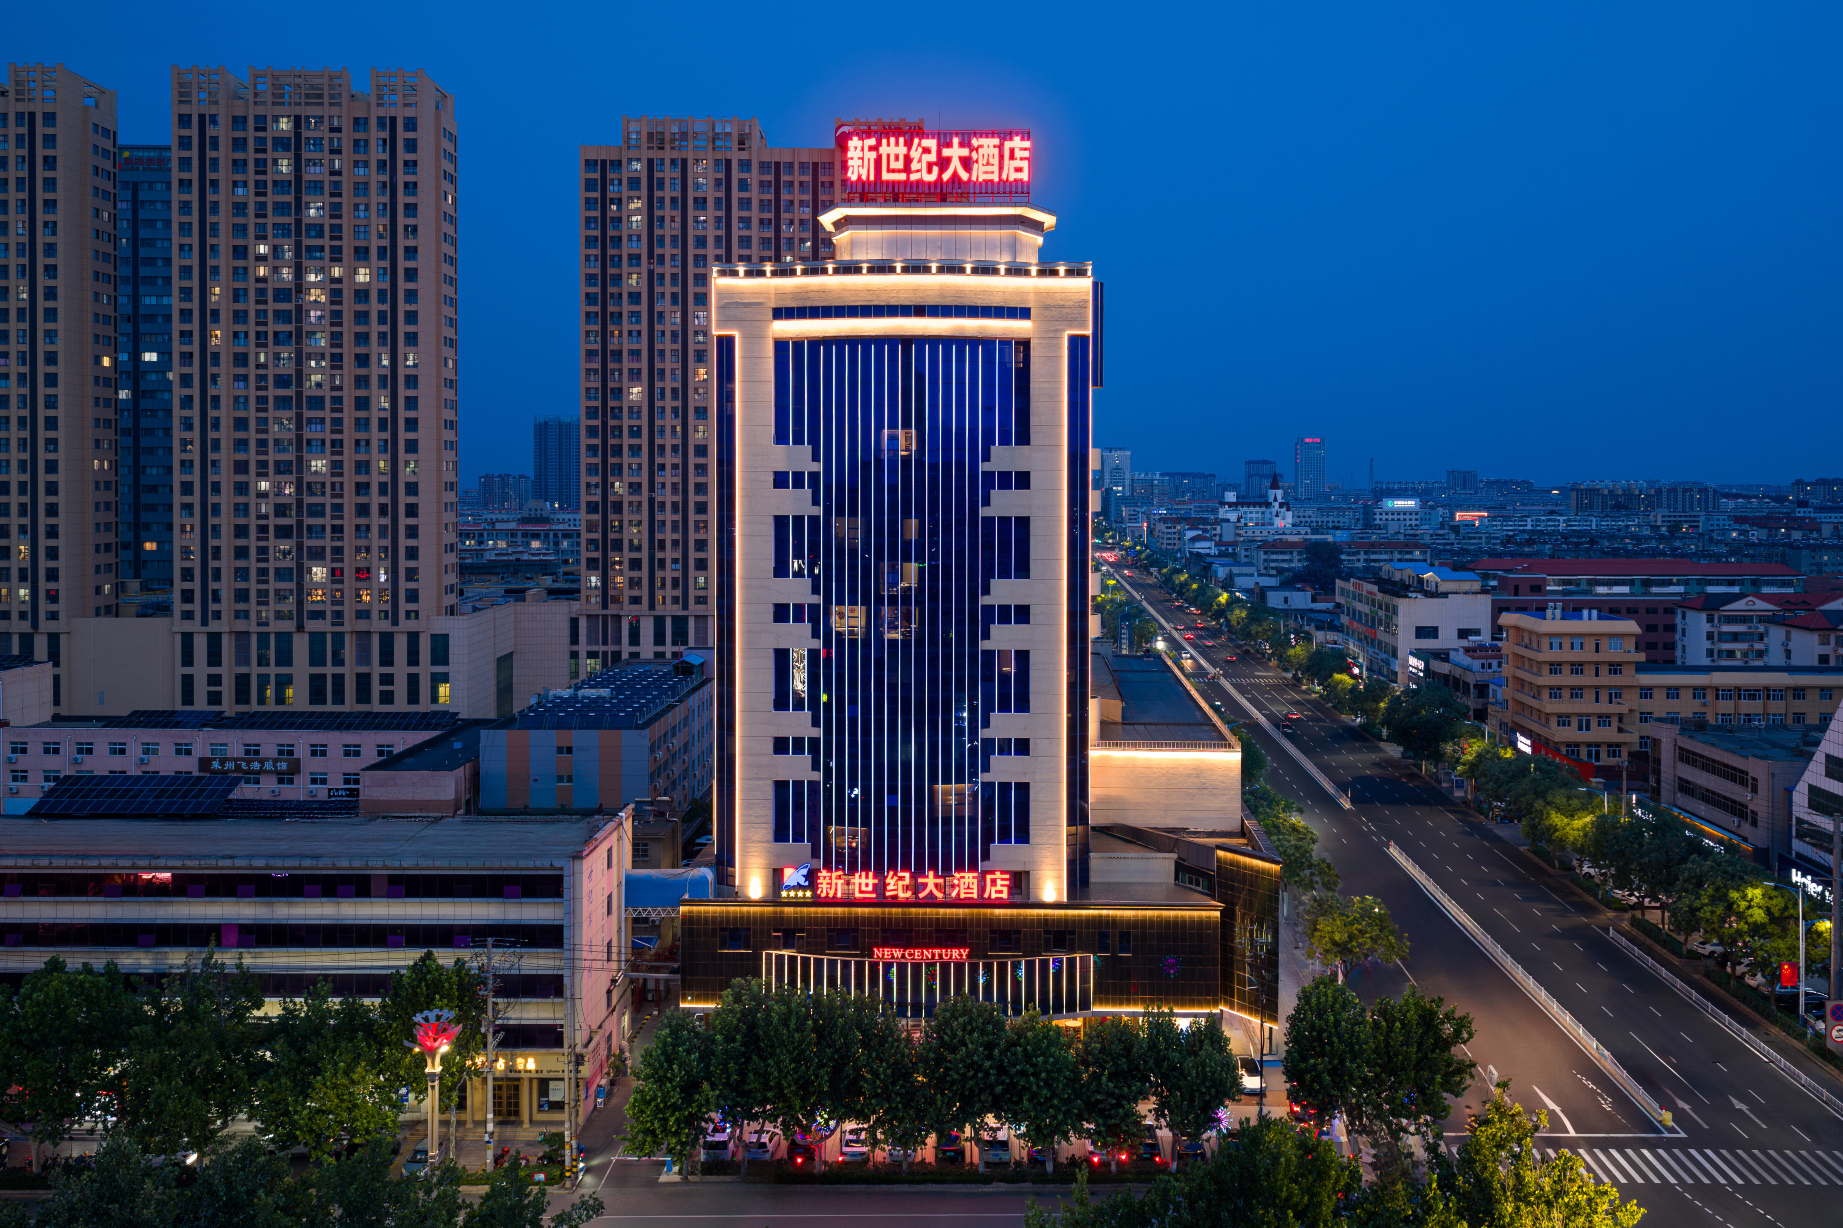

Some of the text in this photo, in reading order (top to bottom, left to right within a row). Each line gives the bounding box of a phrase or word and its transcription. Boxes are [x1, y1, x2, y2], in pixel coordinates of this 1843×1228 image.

[847, 136, 1031, 182] 新世纪大酒店
[210, 758, 288, 770] 莱州飞浩服饰
[817, 869, 1011, 899] 新世纪大酒店
[873, 948, 970, 960] NEW CENTURY
